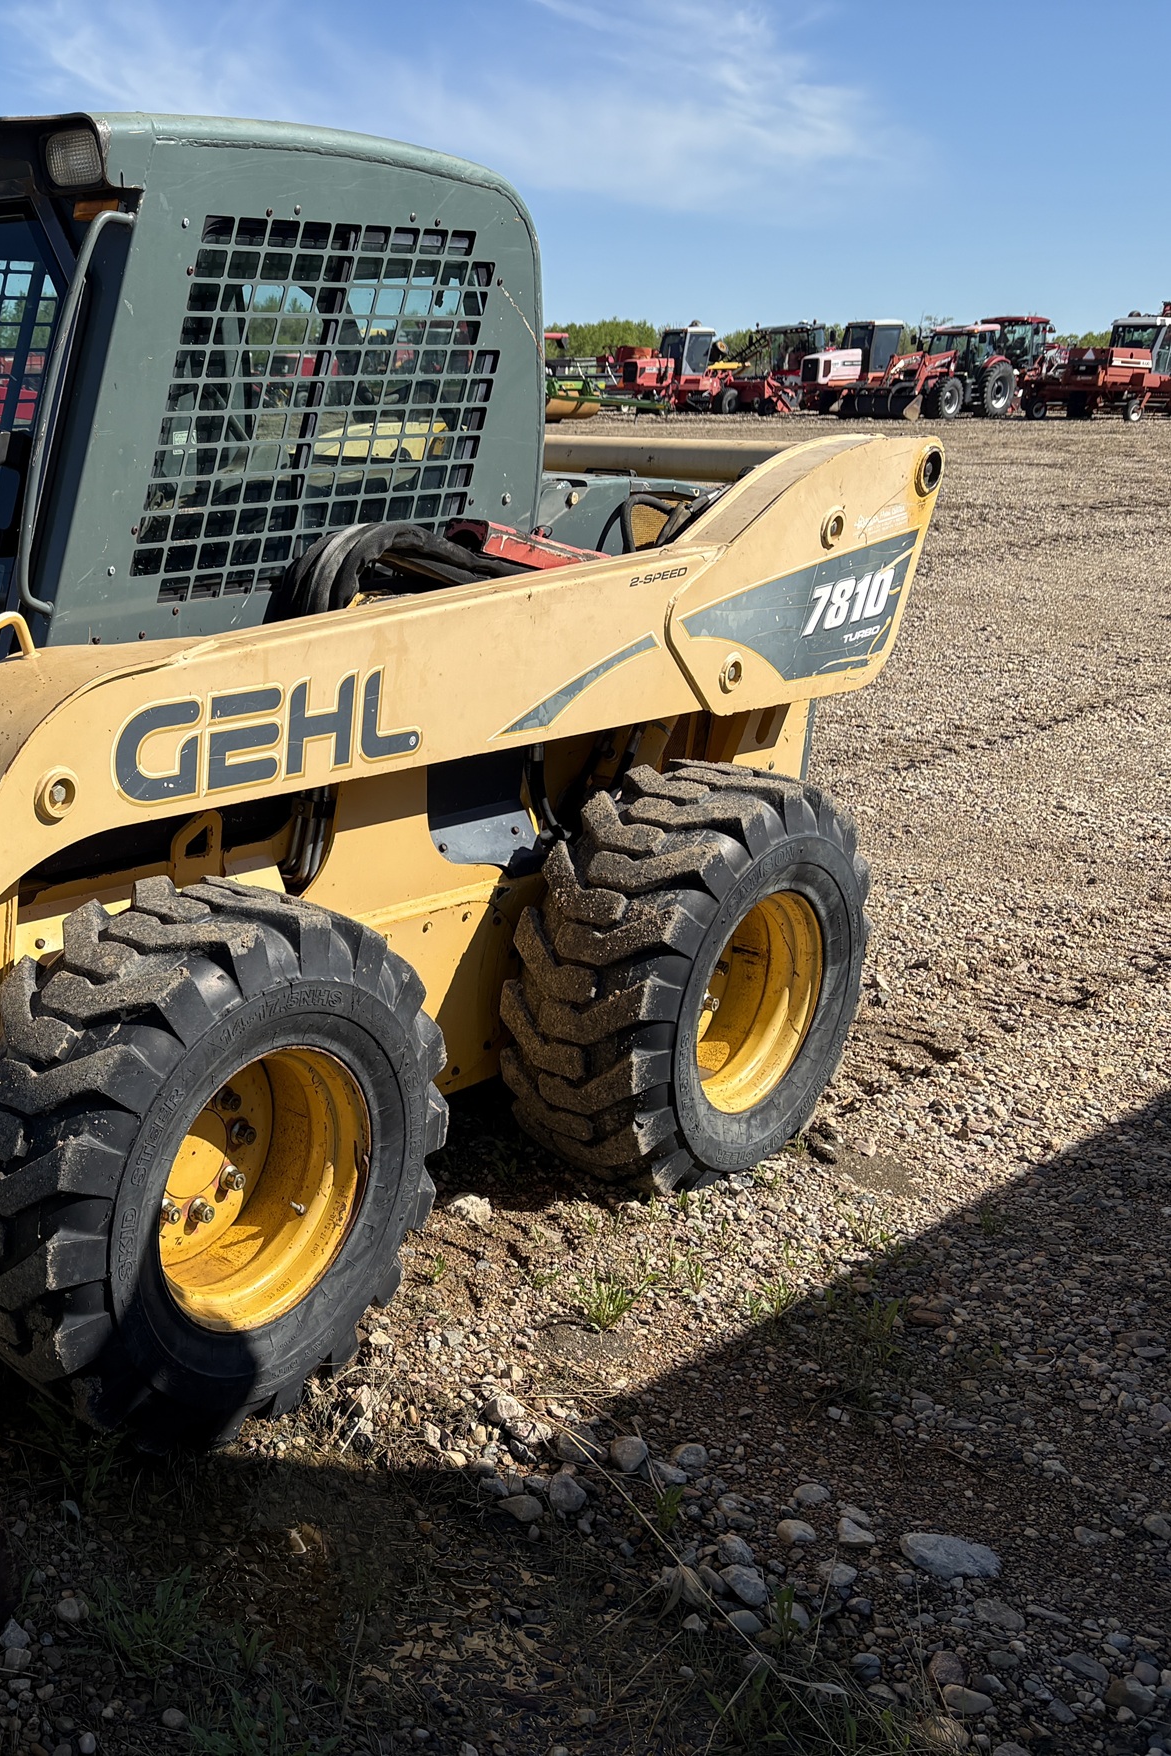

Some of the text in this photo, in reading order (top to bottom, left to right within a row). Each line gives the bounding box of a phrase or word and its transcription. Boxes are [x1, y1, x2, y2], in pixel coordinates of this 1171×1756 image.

[629, 567, 688, 588] 2-SPEED
[801, 567, 896, 639] 7810
[842, 624, 881, 644] TURBO
[113, 668, 421, 805] GEHL
[117, 1087, 186, 1282] SKID STEER
[401, 1071, 424, 1204] SAMSON
